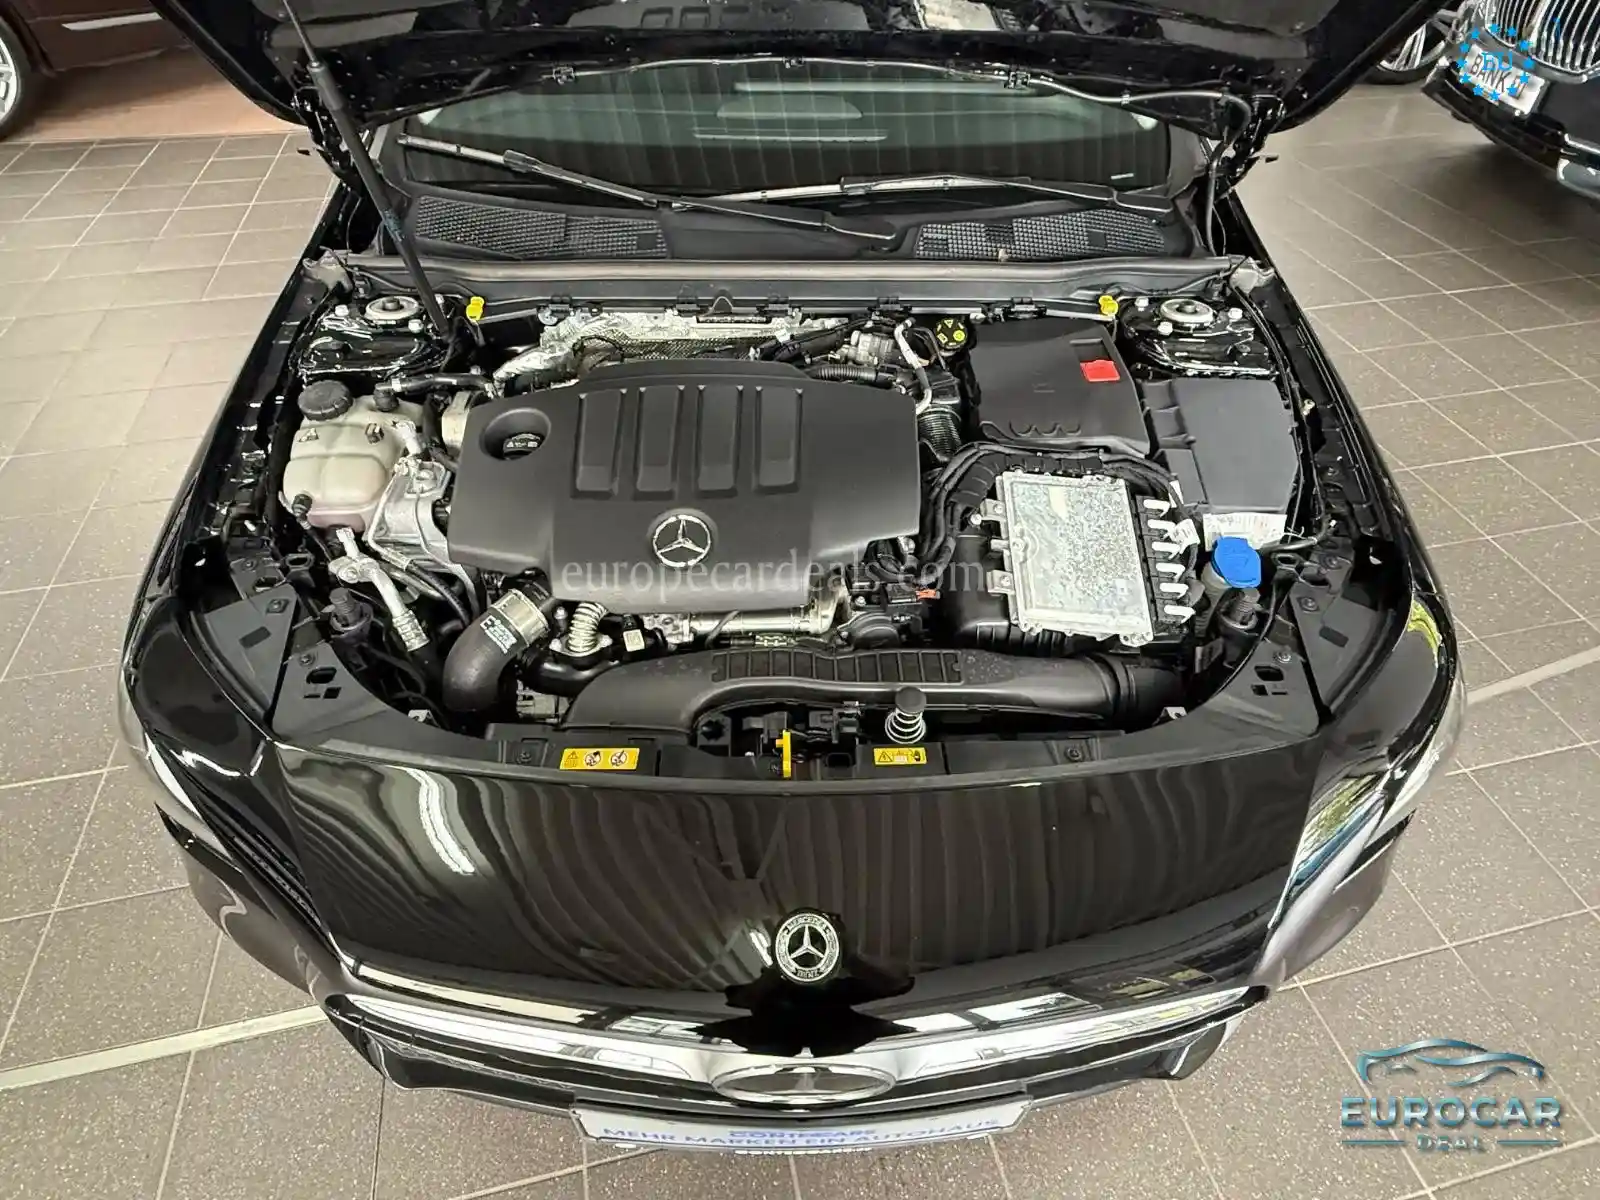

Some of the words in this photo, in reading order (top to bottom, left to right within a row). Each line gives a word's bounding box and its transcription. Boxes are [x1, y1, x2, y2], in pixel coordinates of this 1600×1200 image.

[603, 1128, 675, 1142] MEHR
[685, 1135, 797, 1145] MARKEN
[806, 1137, 846, 1145] EIN
[855, 1119, 999, 1142] AUTOHAUS
